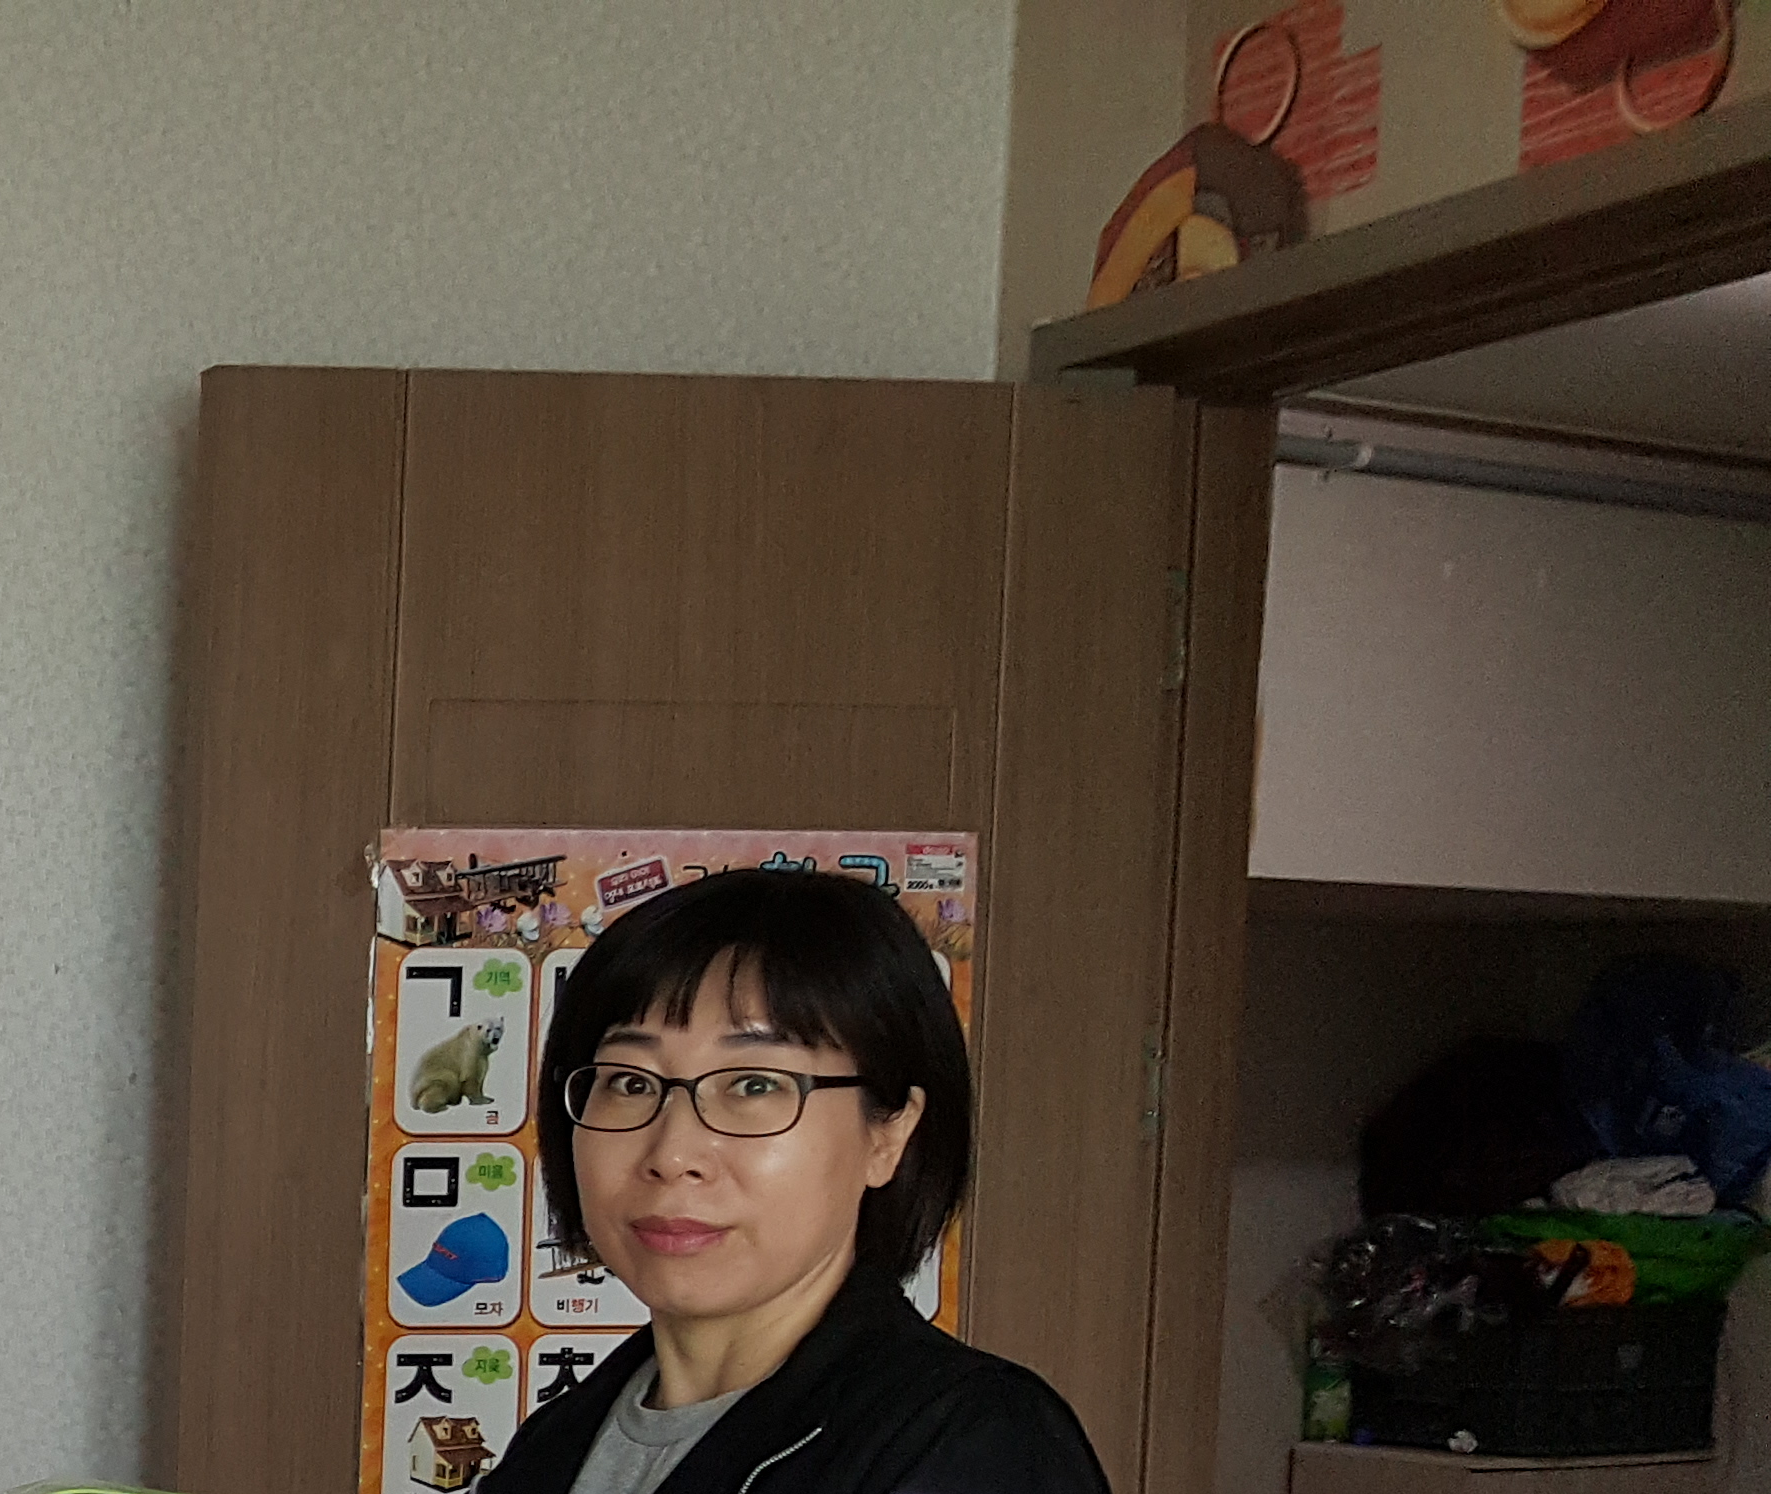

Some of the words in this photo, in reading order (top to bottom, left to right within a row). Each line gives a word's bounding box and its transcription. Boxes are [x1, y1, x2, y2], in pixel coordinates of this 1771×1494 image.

[486, 970, 511, 986] 기역
[477, 1163, 504, 1180] 미음
[474, 1301, 504, 1317] 모자
[556, 1297, 600, 1314] 비행기
